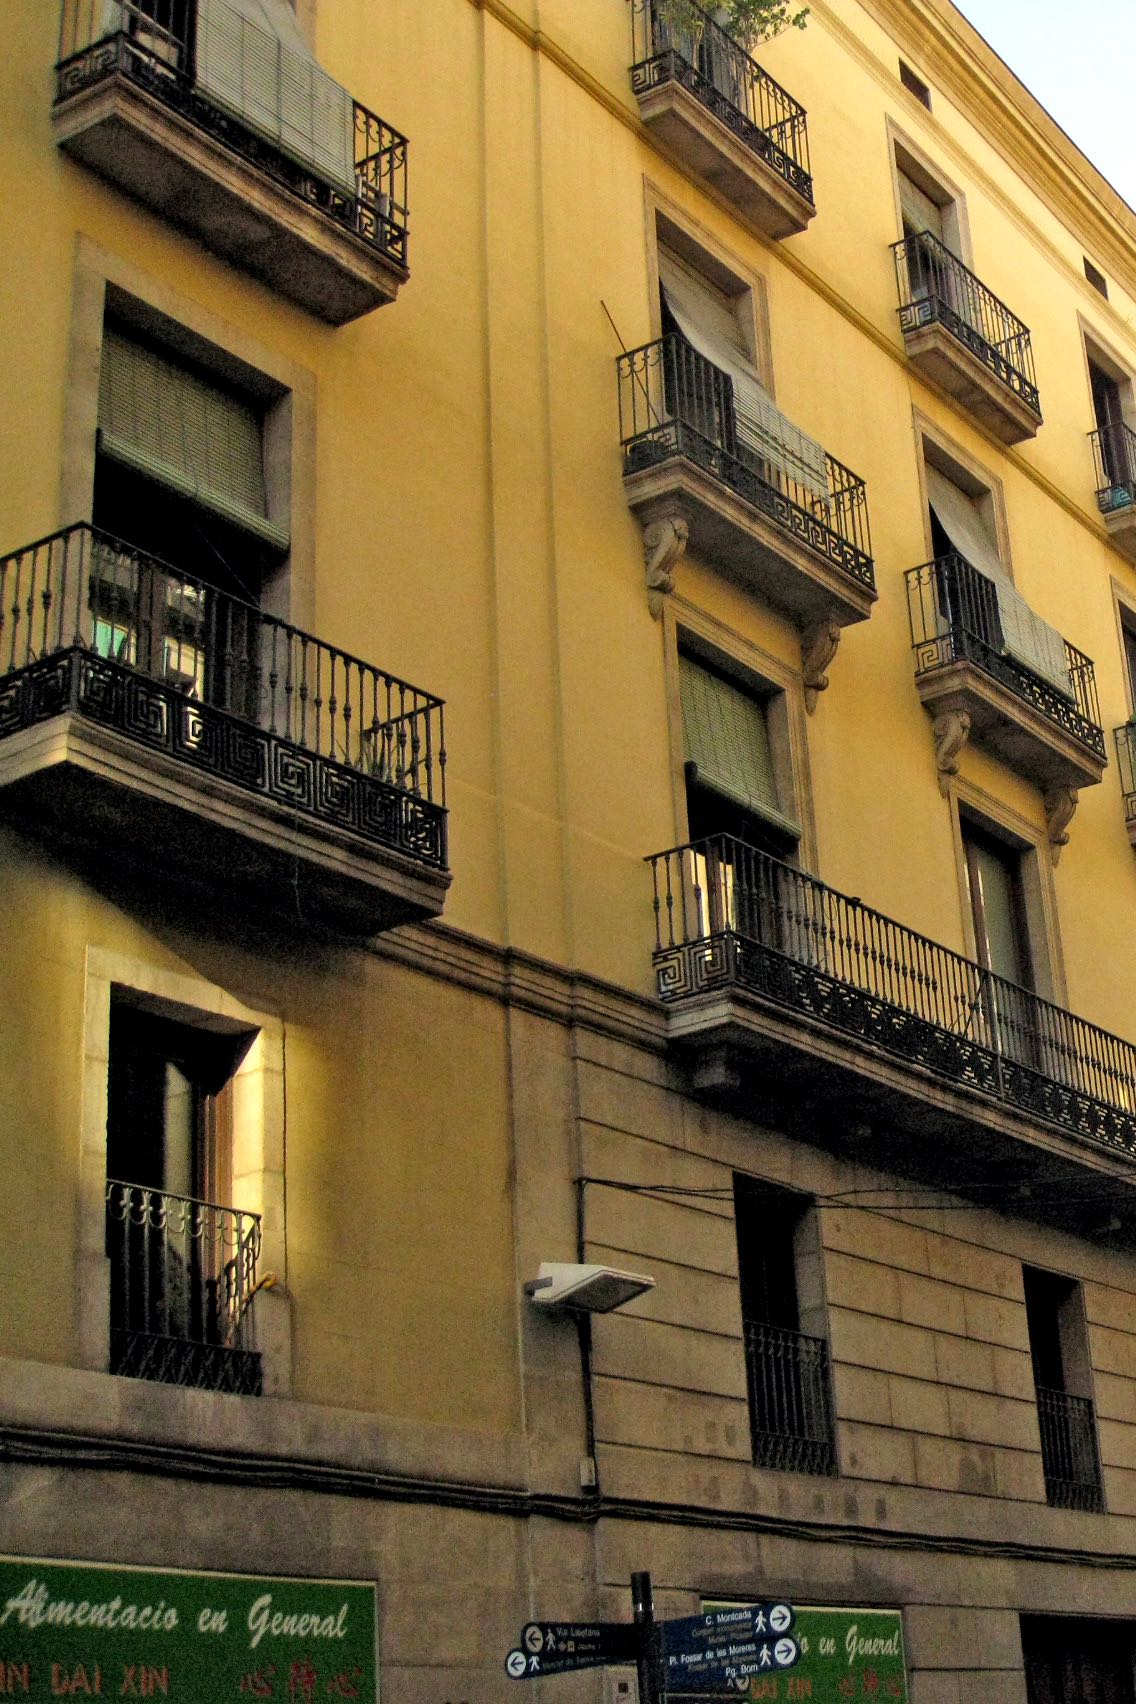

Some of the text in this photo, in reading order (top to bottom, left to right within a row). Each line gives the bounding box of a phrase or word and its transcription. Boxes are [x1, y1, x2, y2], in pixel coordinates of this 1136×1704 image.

[198, 1607, 230, 1634] en
[248, 1593, 349, 1649] General
[705, 1649, 715, 1660] de
[819, 1636, 837, 1656] en
[845, 1625, 900, 1666] General
[119, 1663, 171, 1697] XIN
